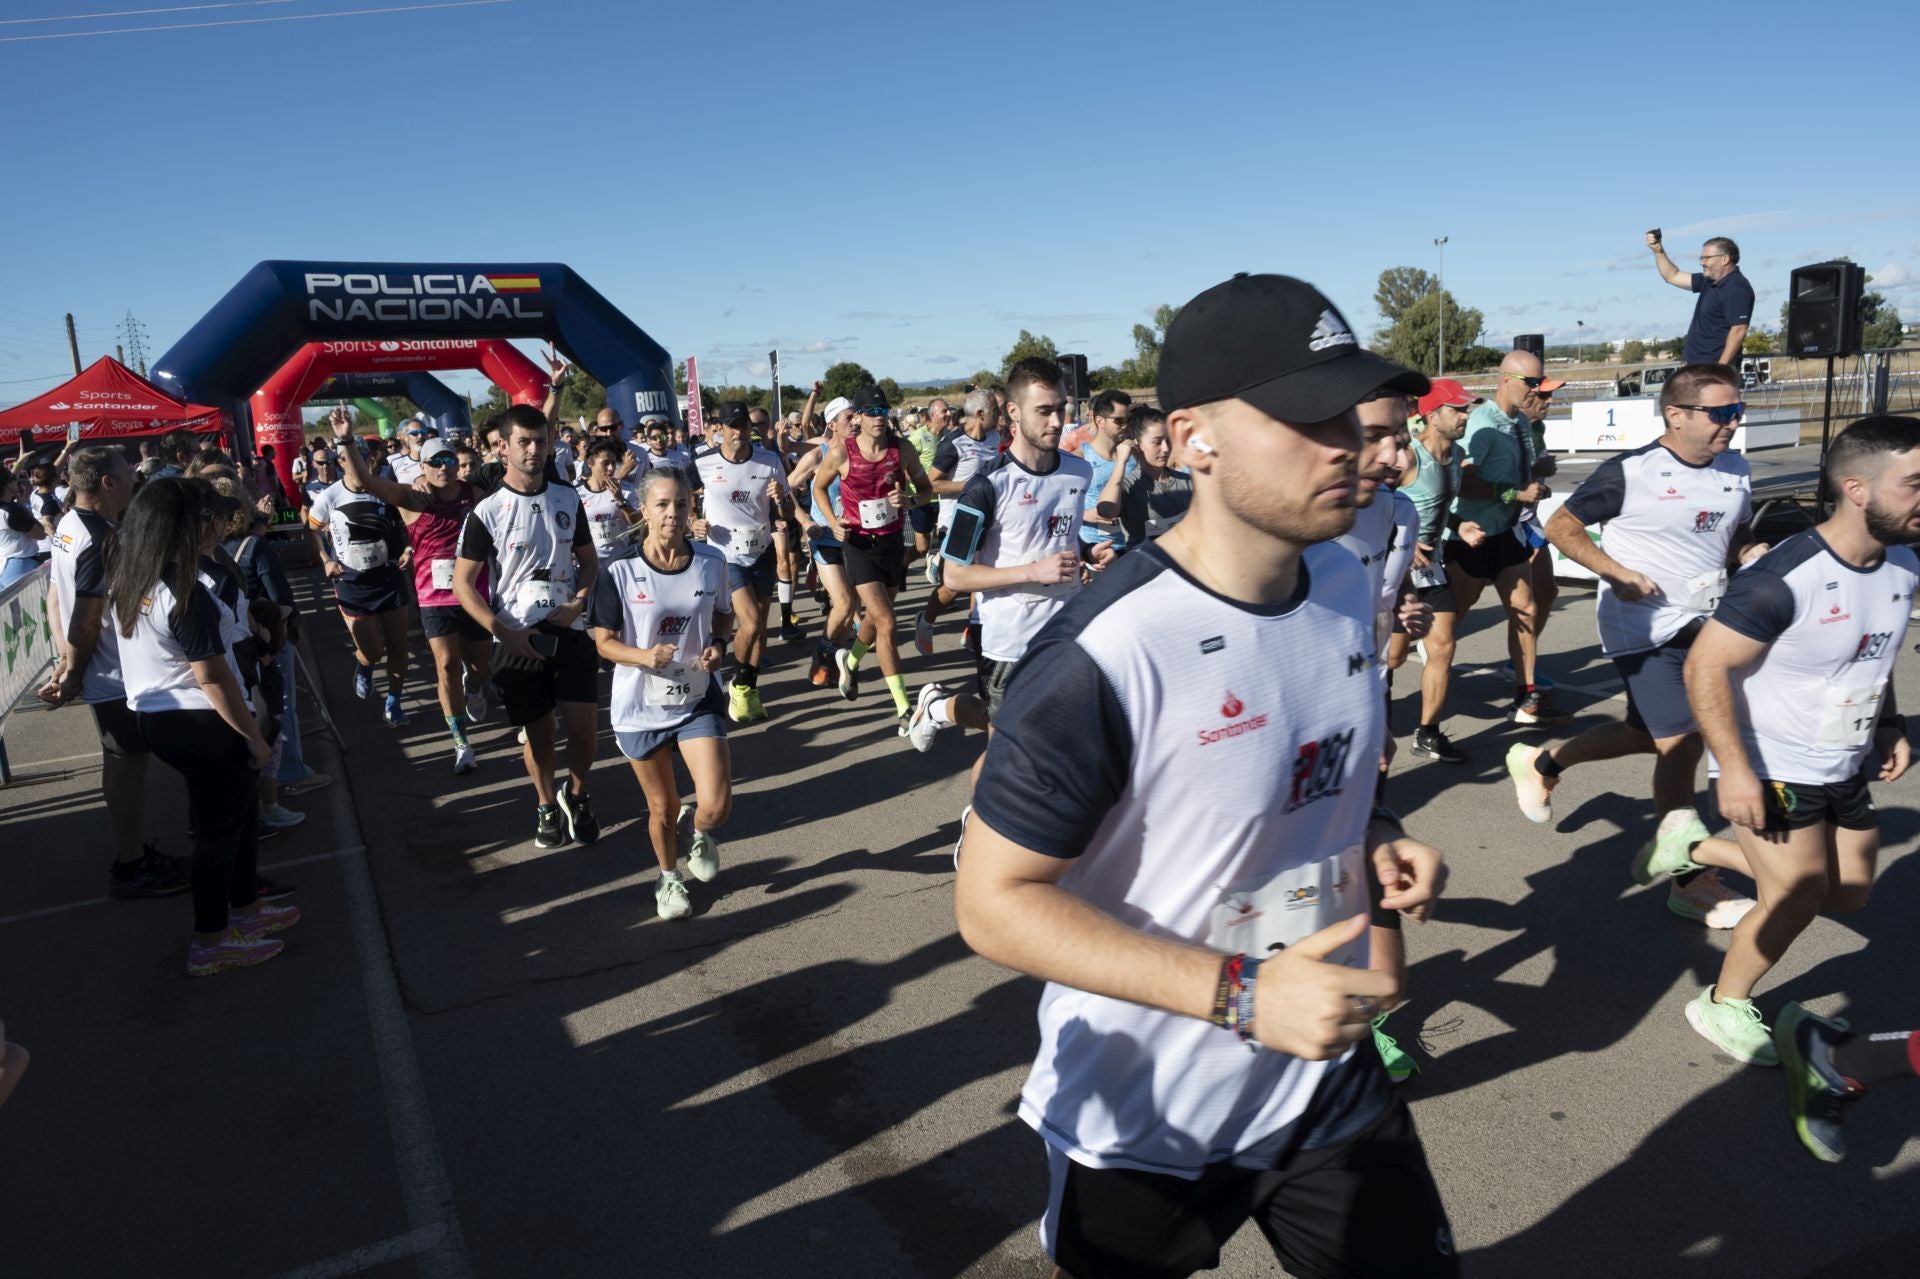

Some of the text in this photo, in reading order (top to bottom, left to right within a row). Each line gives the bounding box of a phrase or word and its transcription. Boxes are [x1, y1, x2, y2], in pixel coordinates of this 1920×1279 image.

[308, 298, 544, 321] NACIONAL
[80, 390, 132, 401] Sports
[72, 401, 159, 411] Santander
[635, 391, 669, 412] RUTA
[1606, 408, 1617, 427] 1
[44, 423, 95, 434] Santder
[111, 419, 144, 431] Sports
[876, 512, 887, 521] 69
[534, 599, 556, 609] 126
[666, 683, 691, 695] 216
